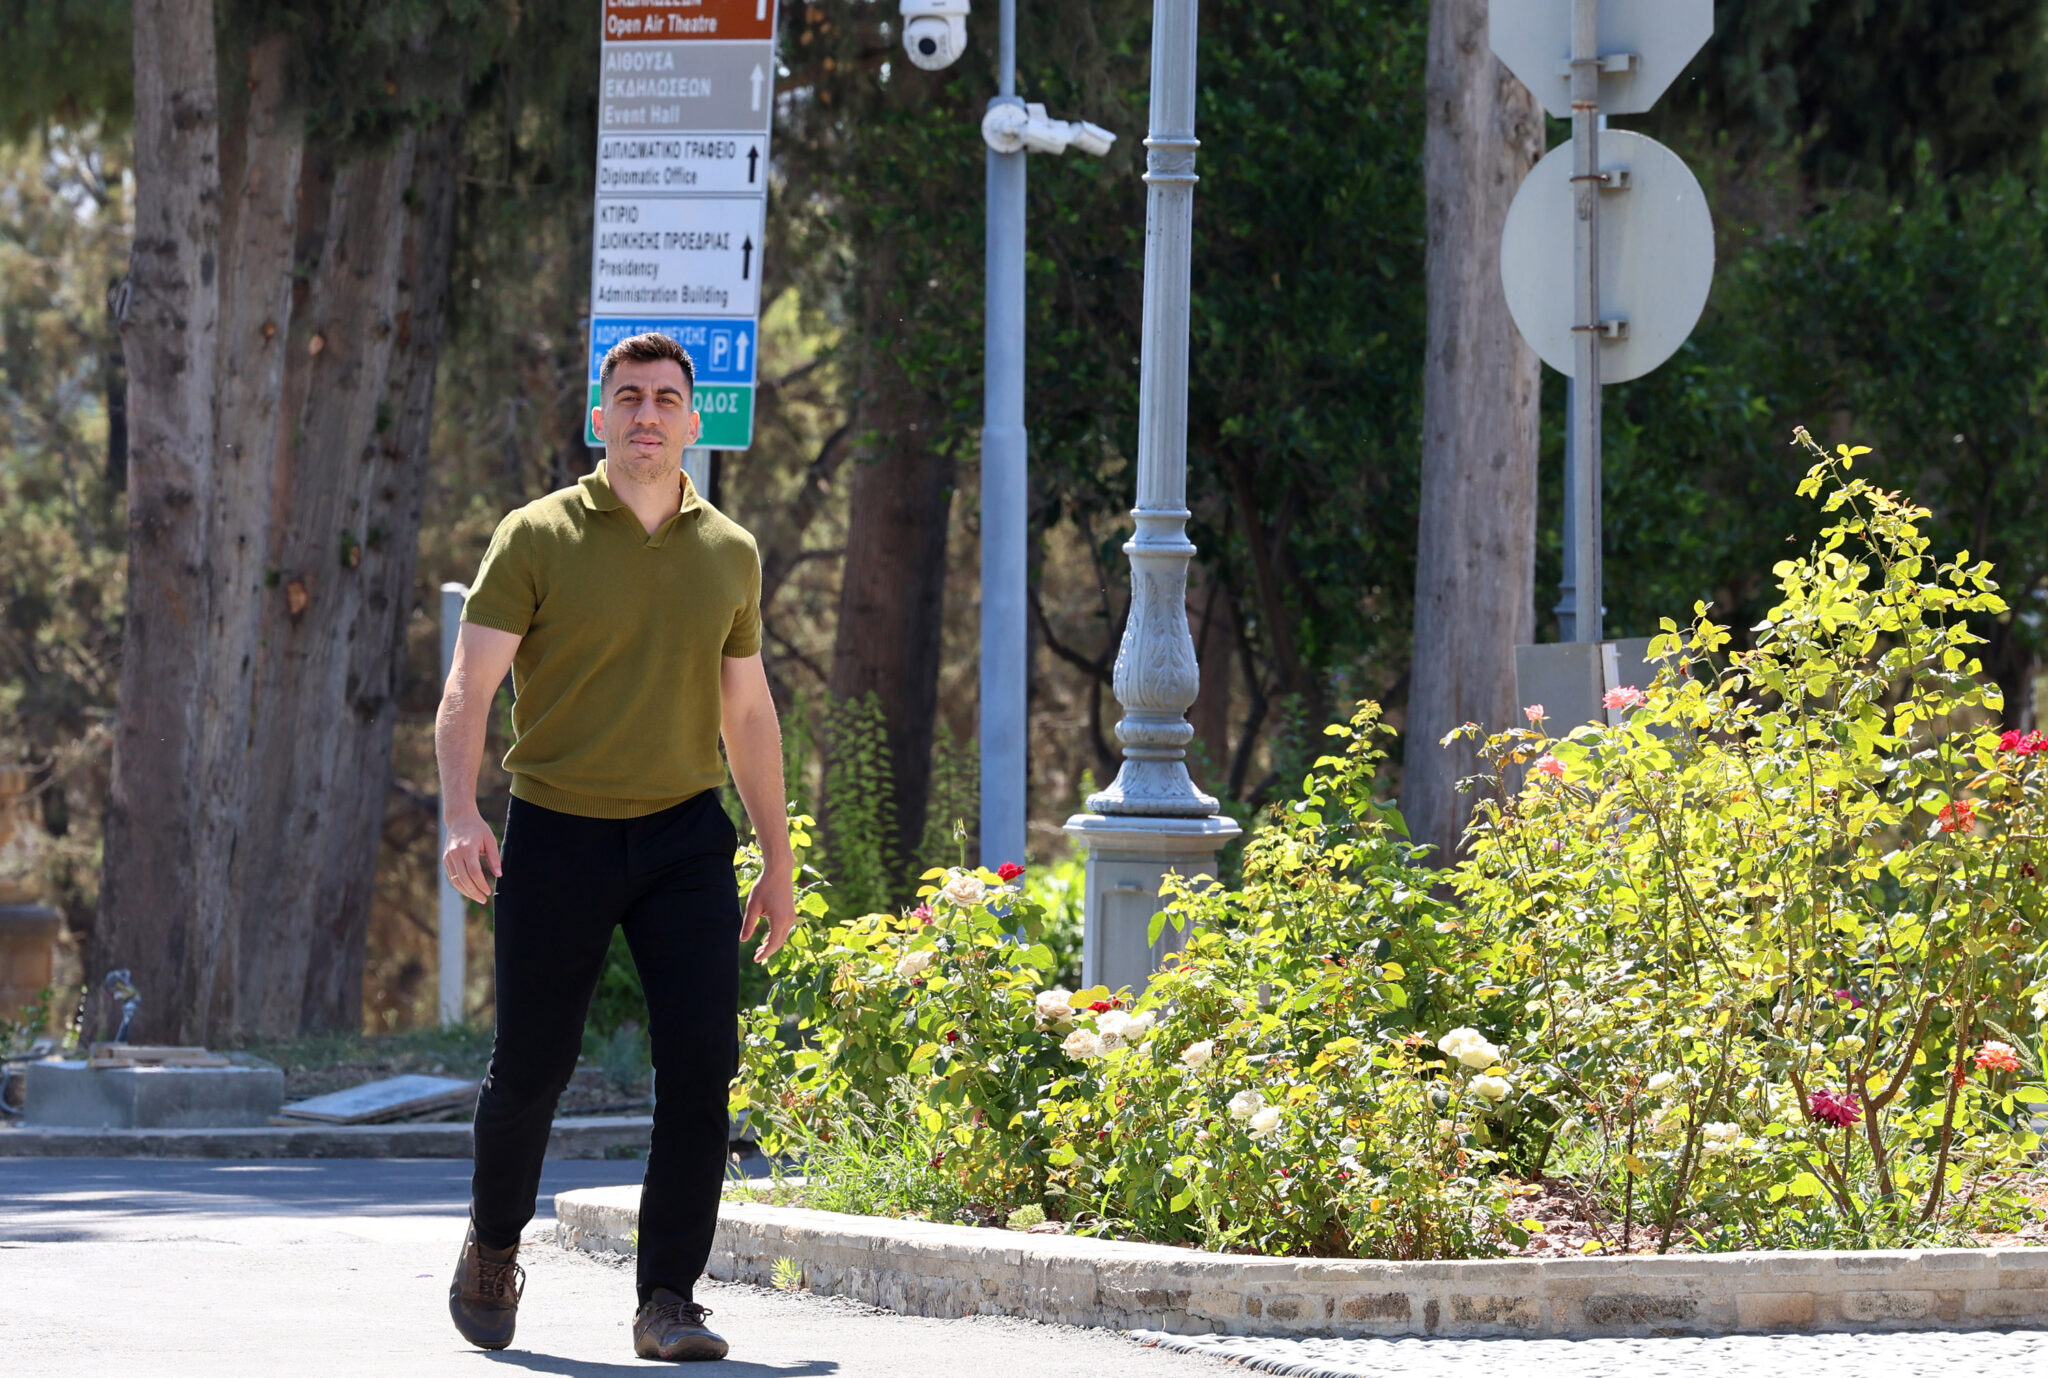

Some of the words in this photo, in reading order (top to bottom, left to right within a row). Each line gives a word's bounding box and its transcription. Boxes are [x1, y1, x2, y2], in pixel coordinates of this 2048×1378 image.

[607, 14, 641, 38] Open
[644, 14, 664, 33] Air
[668, 14, 718, 33] Theatre
[606, 51, 675, 71] ΑΙΘΟΥΣΑ
[605, 78, 712, 97] ΕΚΔΗΛΩΣΕΩΝ
[604, 105, 646, 124] Event
[650, 104, 681, 123] Hall
[602, 141, 681, 159] ΔΙΠΛΩΜΑΤΙΚΟ
[684, 141, 736, 159] ΓΡΑΦΕΙΟ
[601, 167, 659, 188] Diplomatic
[663, 166, 697, 185] Office
[601, 205, 639, 224] ΚΤΙΡΙΟ
[600, 232, 660, 250] ΔΙΟΙΚΗΣΗΣ
[664, 232, 730, 250] ΠΡΟΕΔΡΙΑΣ
[599, 258, 659, 280] Presidency
[598, 286, 677, 304] Administration
[681, 285, 728, 308] Building
[713, 336, 728, 365] P
